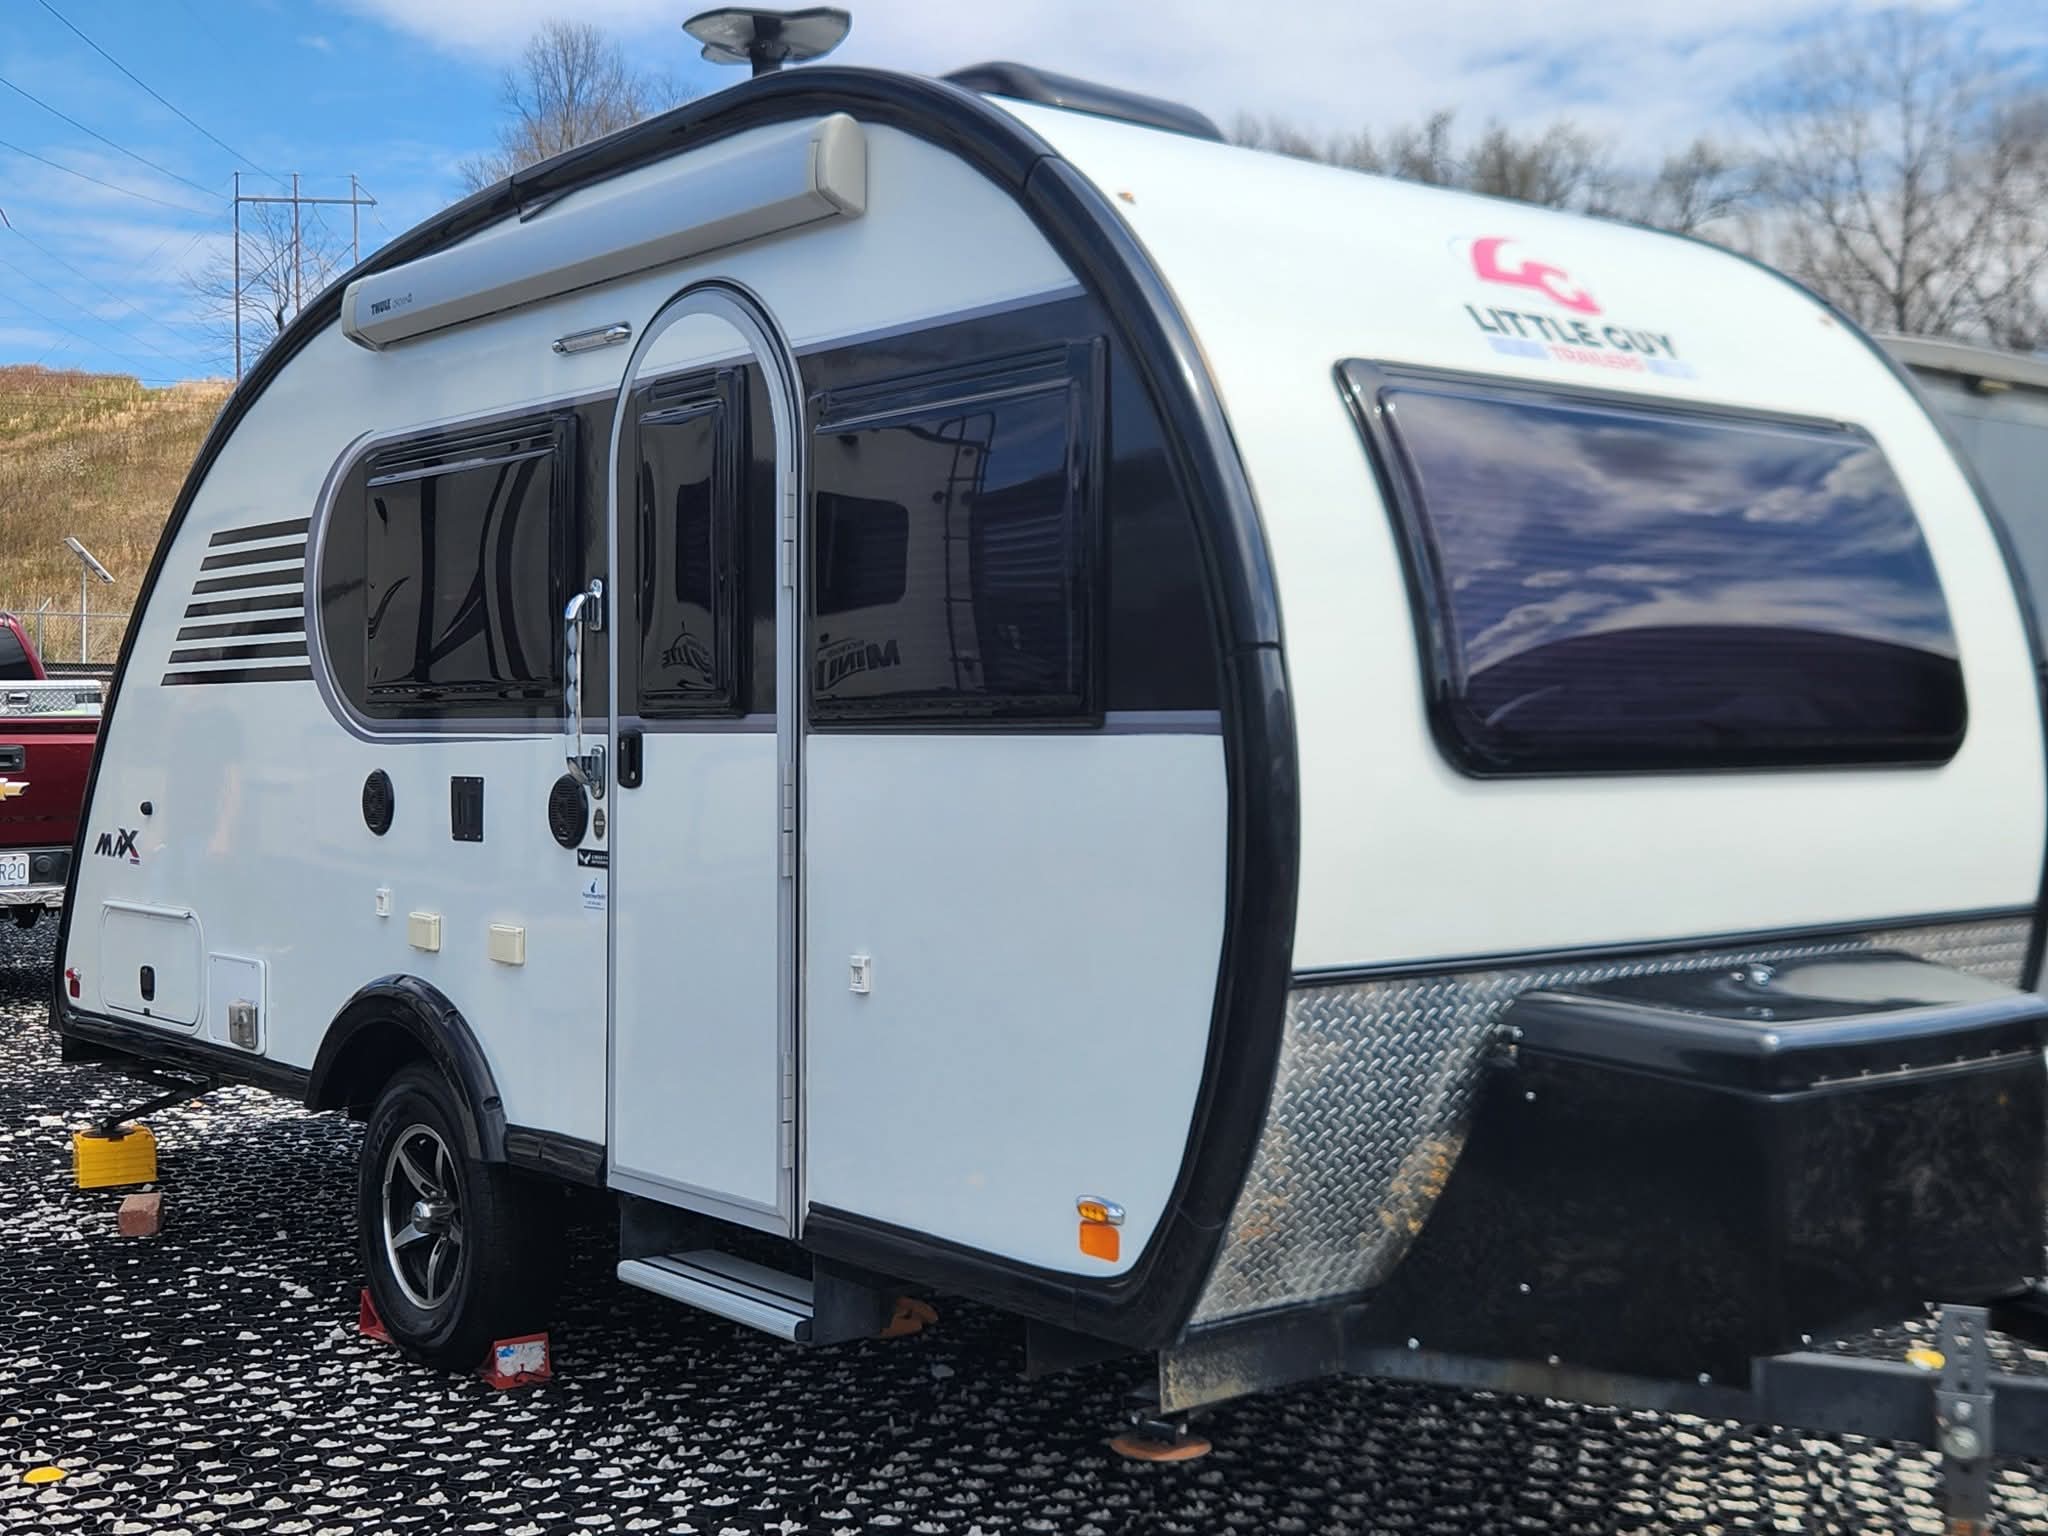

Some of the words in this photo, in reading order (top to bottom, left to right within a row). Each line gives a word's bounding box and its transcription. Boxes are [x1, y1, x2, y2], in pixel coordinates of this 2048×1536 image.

[1464, 303, 1603, 348] LITTLE
[1603, 325, 1678, 360] GUY
[94, 828, 139, 858] MAX
